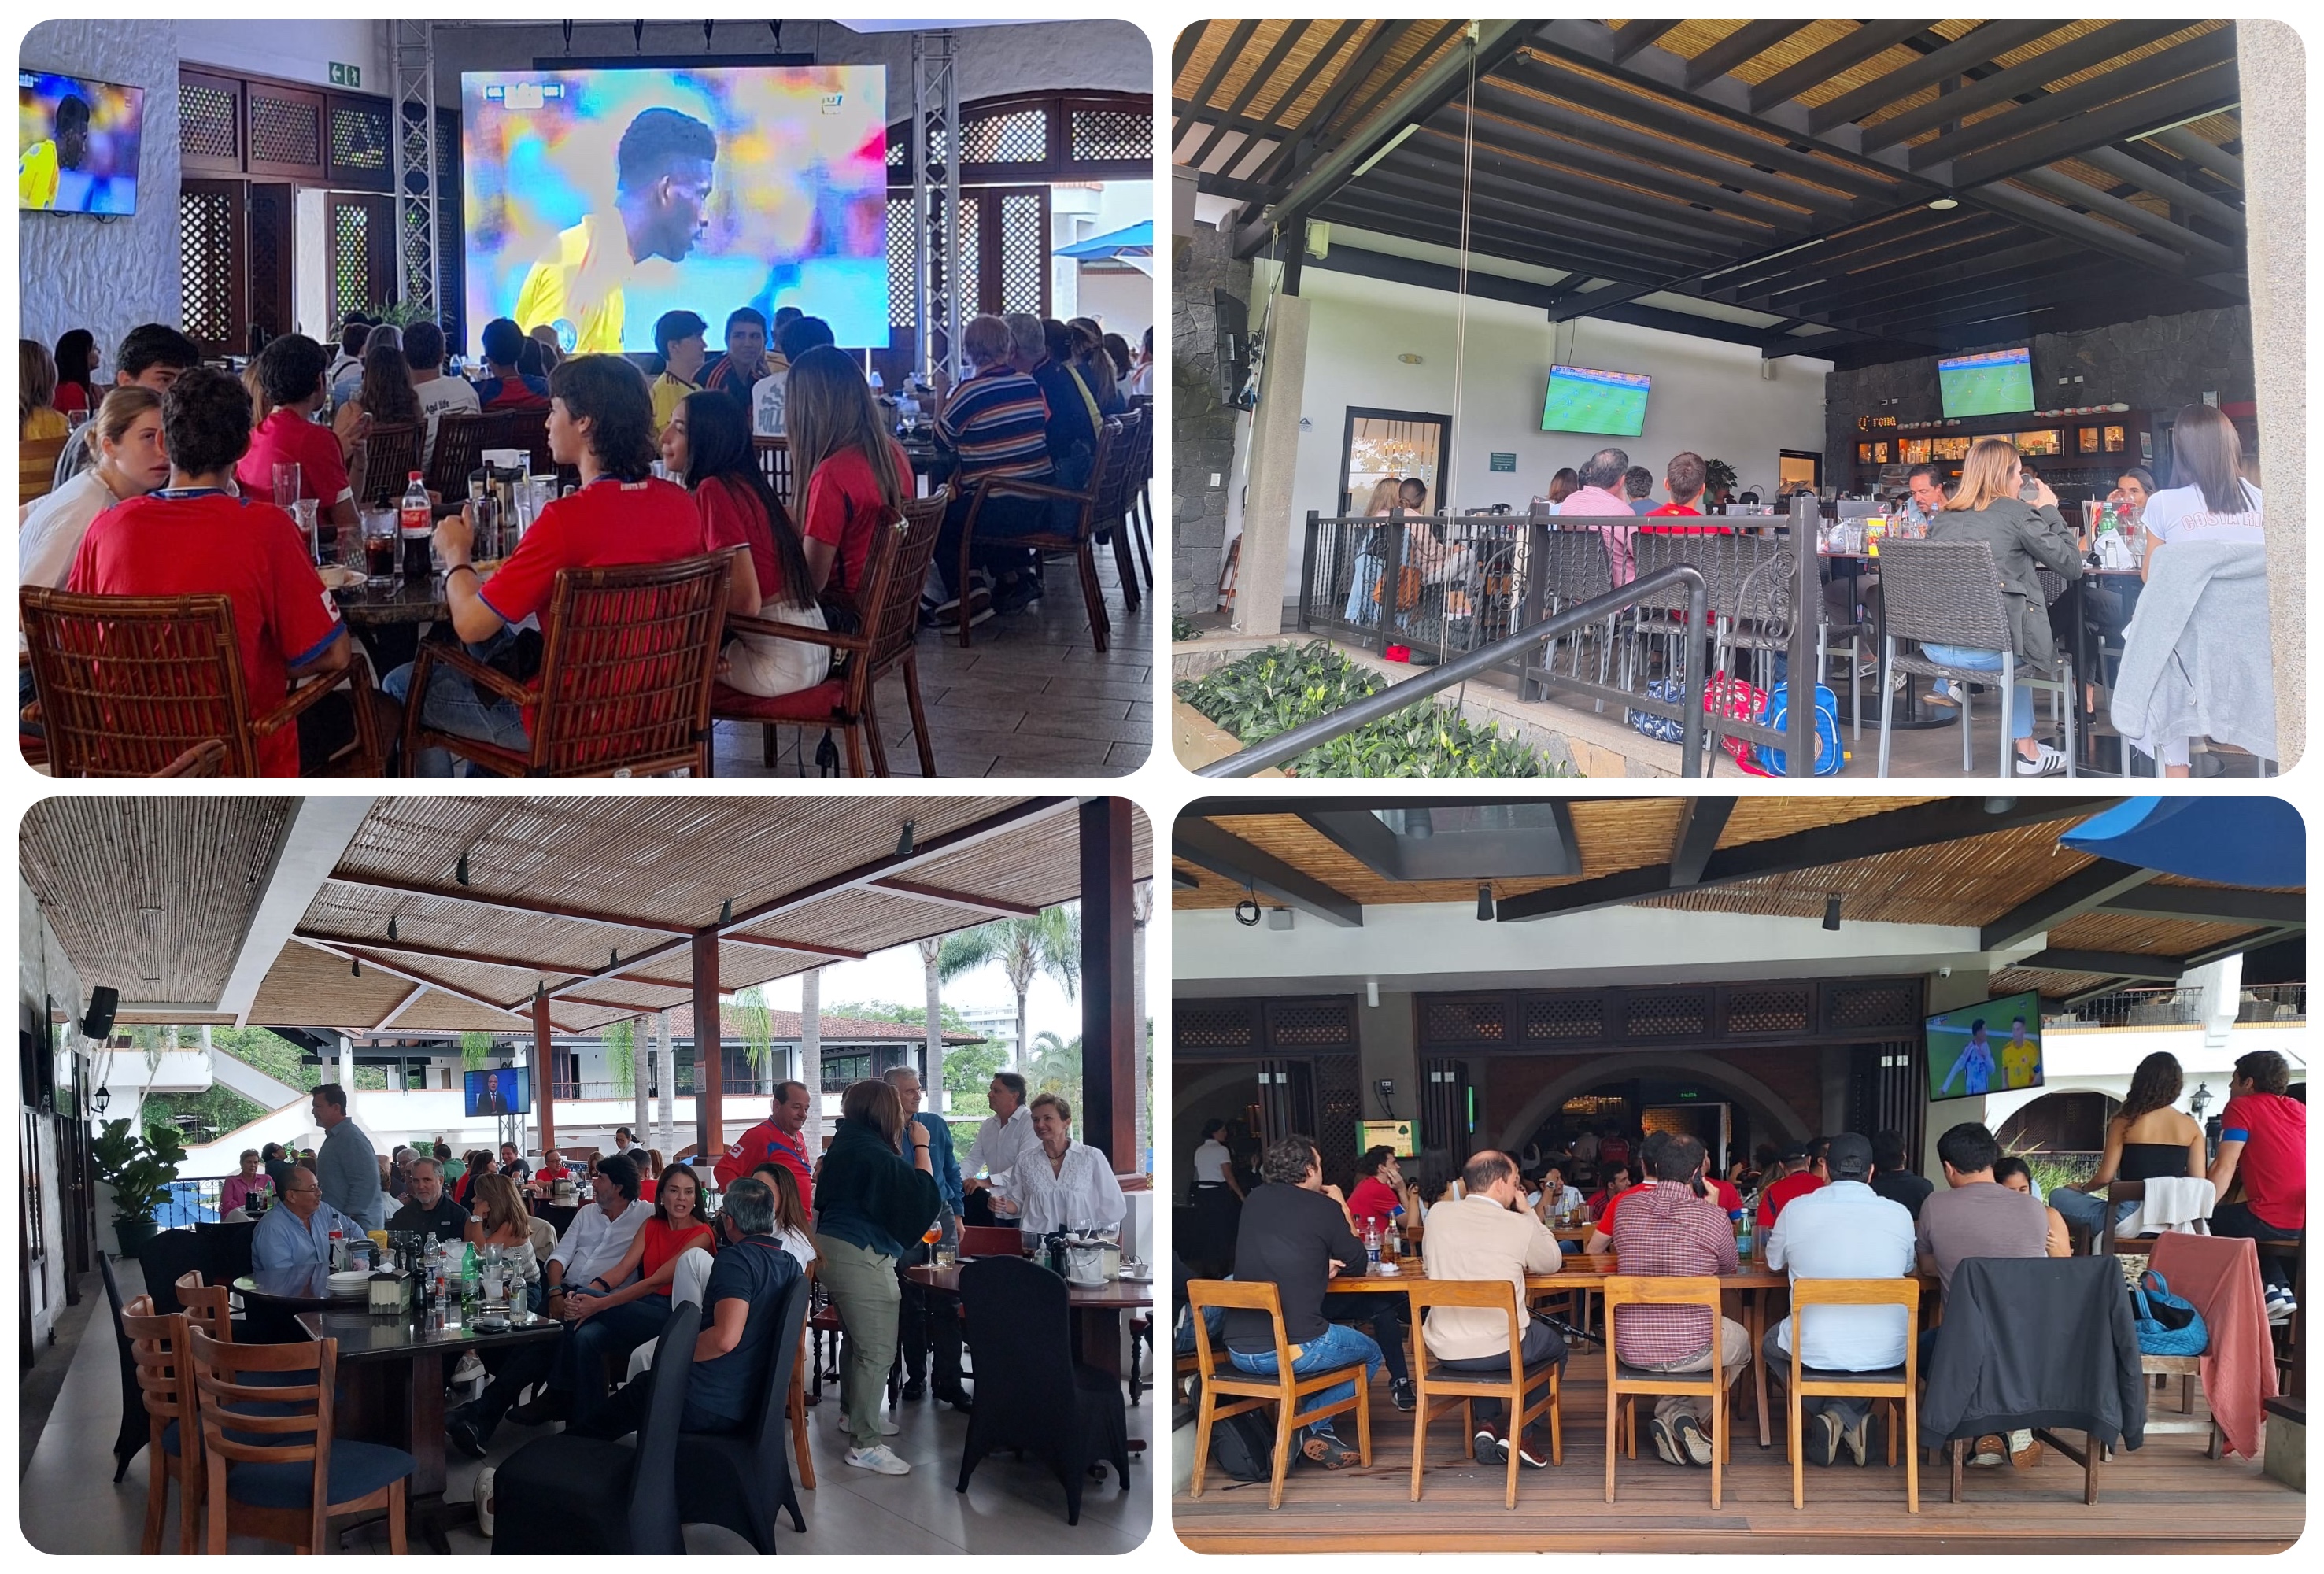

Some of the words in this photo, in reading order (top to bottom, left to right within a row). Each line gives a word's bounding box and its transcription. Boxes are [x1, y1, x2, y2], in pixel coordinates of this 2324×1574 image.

[1858, 416, 1896, 432] Crona
[2182, 510, 2239, 531] COSTA
[2243, 511, 2265, 527] RI
